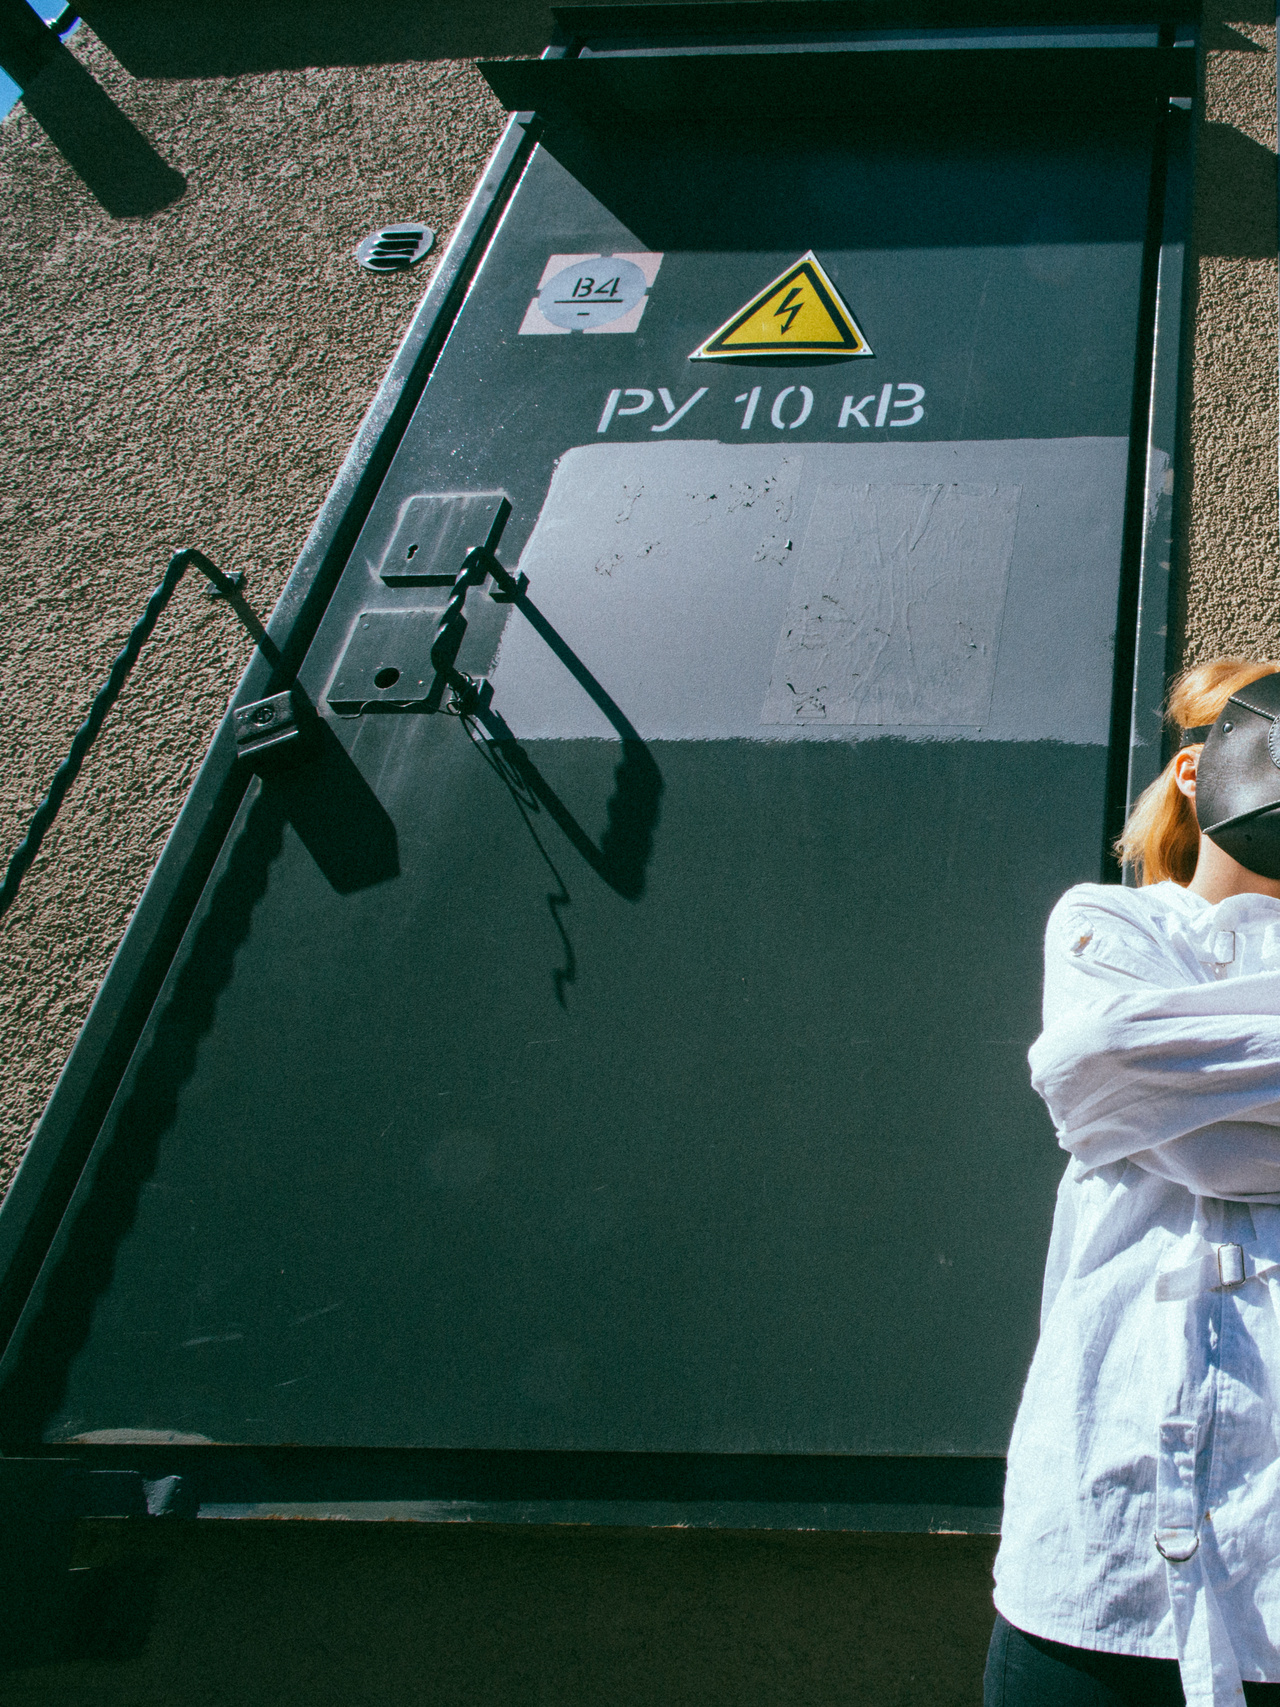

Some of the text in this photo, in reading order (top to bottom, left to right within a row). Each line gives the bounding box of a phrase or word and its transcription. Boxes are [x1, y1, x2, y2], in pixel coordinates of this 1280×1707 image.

[571, 276, 621, 298] В4
[597, 383, 926, 433] РУ 10 кВ
